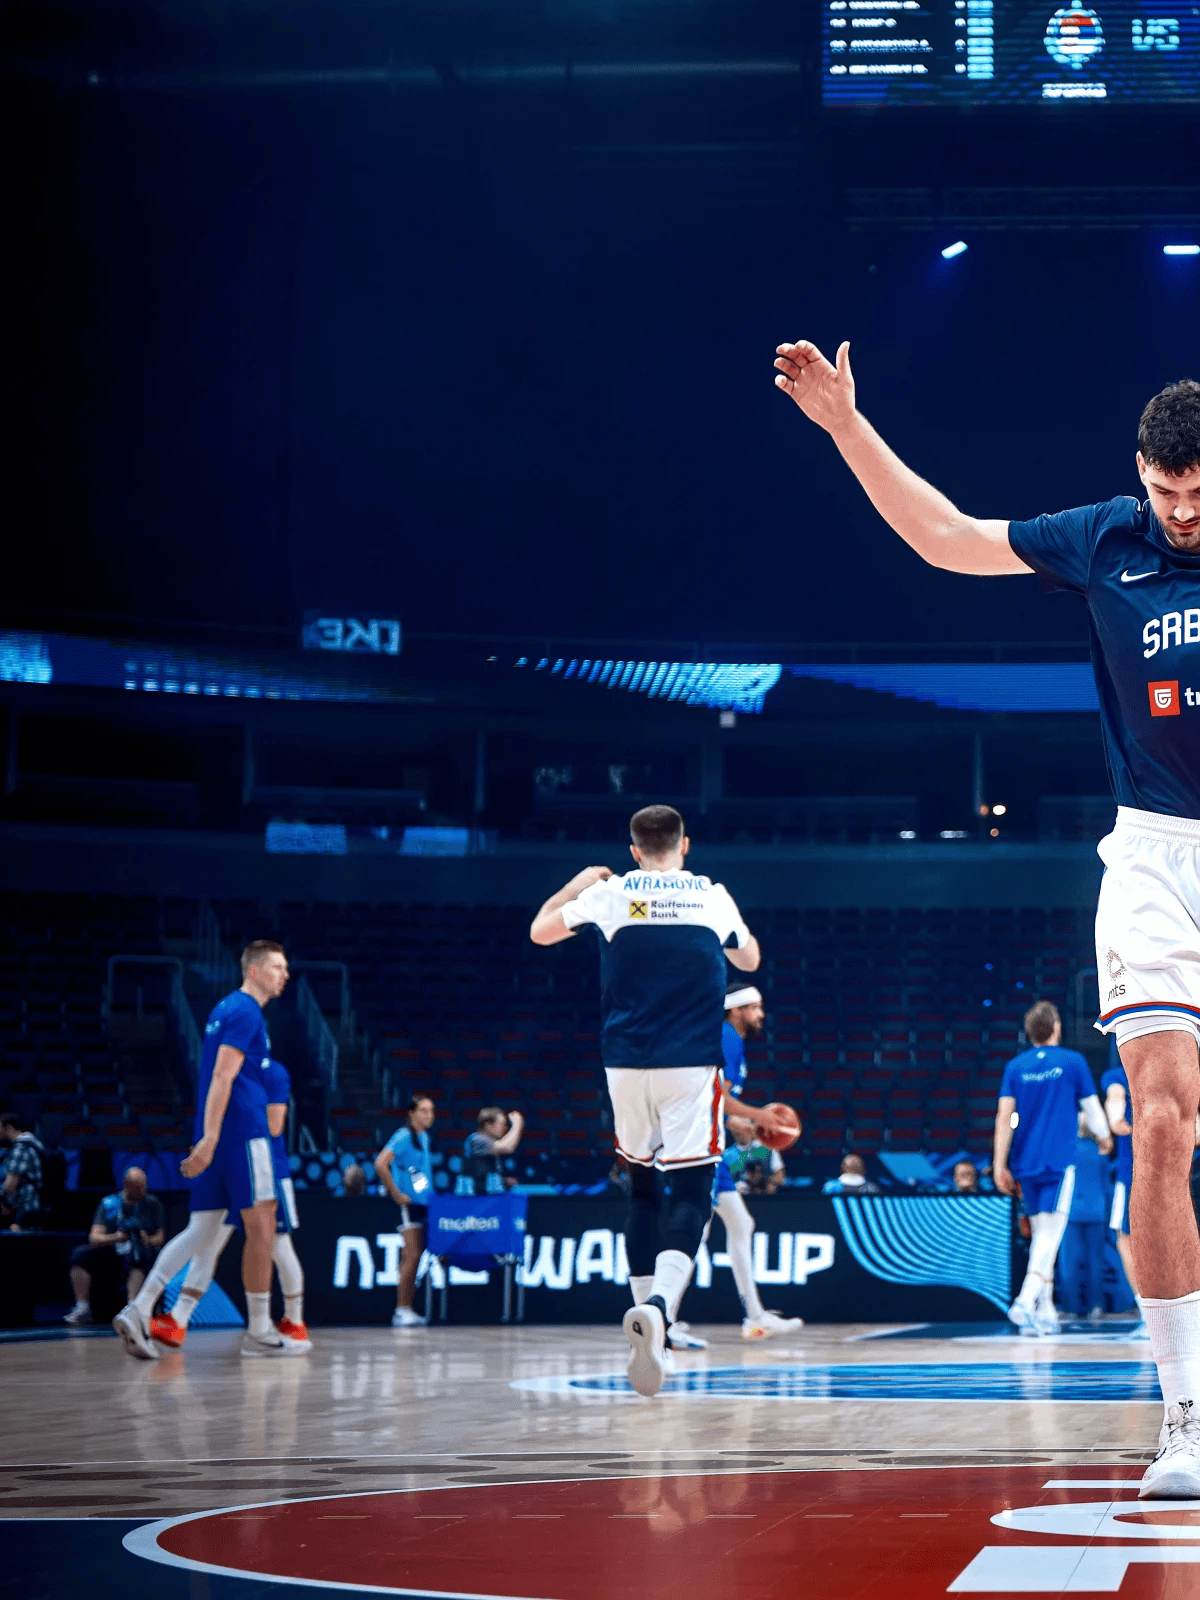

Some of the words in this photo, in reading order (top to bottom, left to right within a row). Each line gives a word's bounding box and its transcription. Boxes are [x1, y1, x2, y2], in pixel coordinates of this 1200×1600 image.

[650, 899, 704, 909] Raiffeisen
[650, 910, 679, 919] Bank
[1107, 984, 1126, 1002] mts
